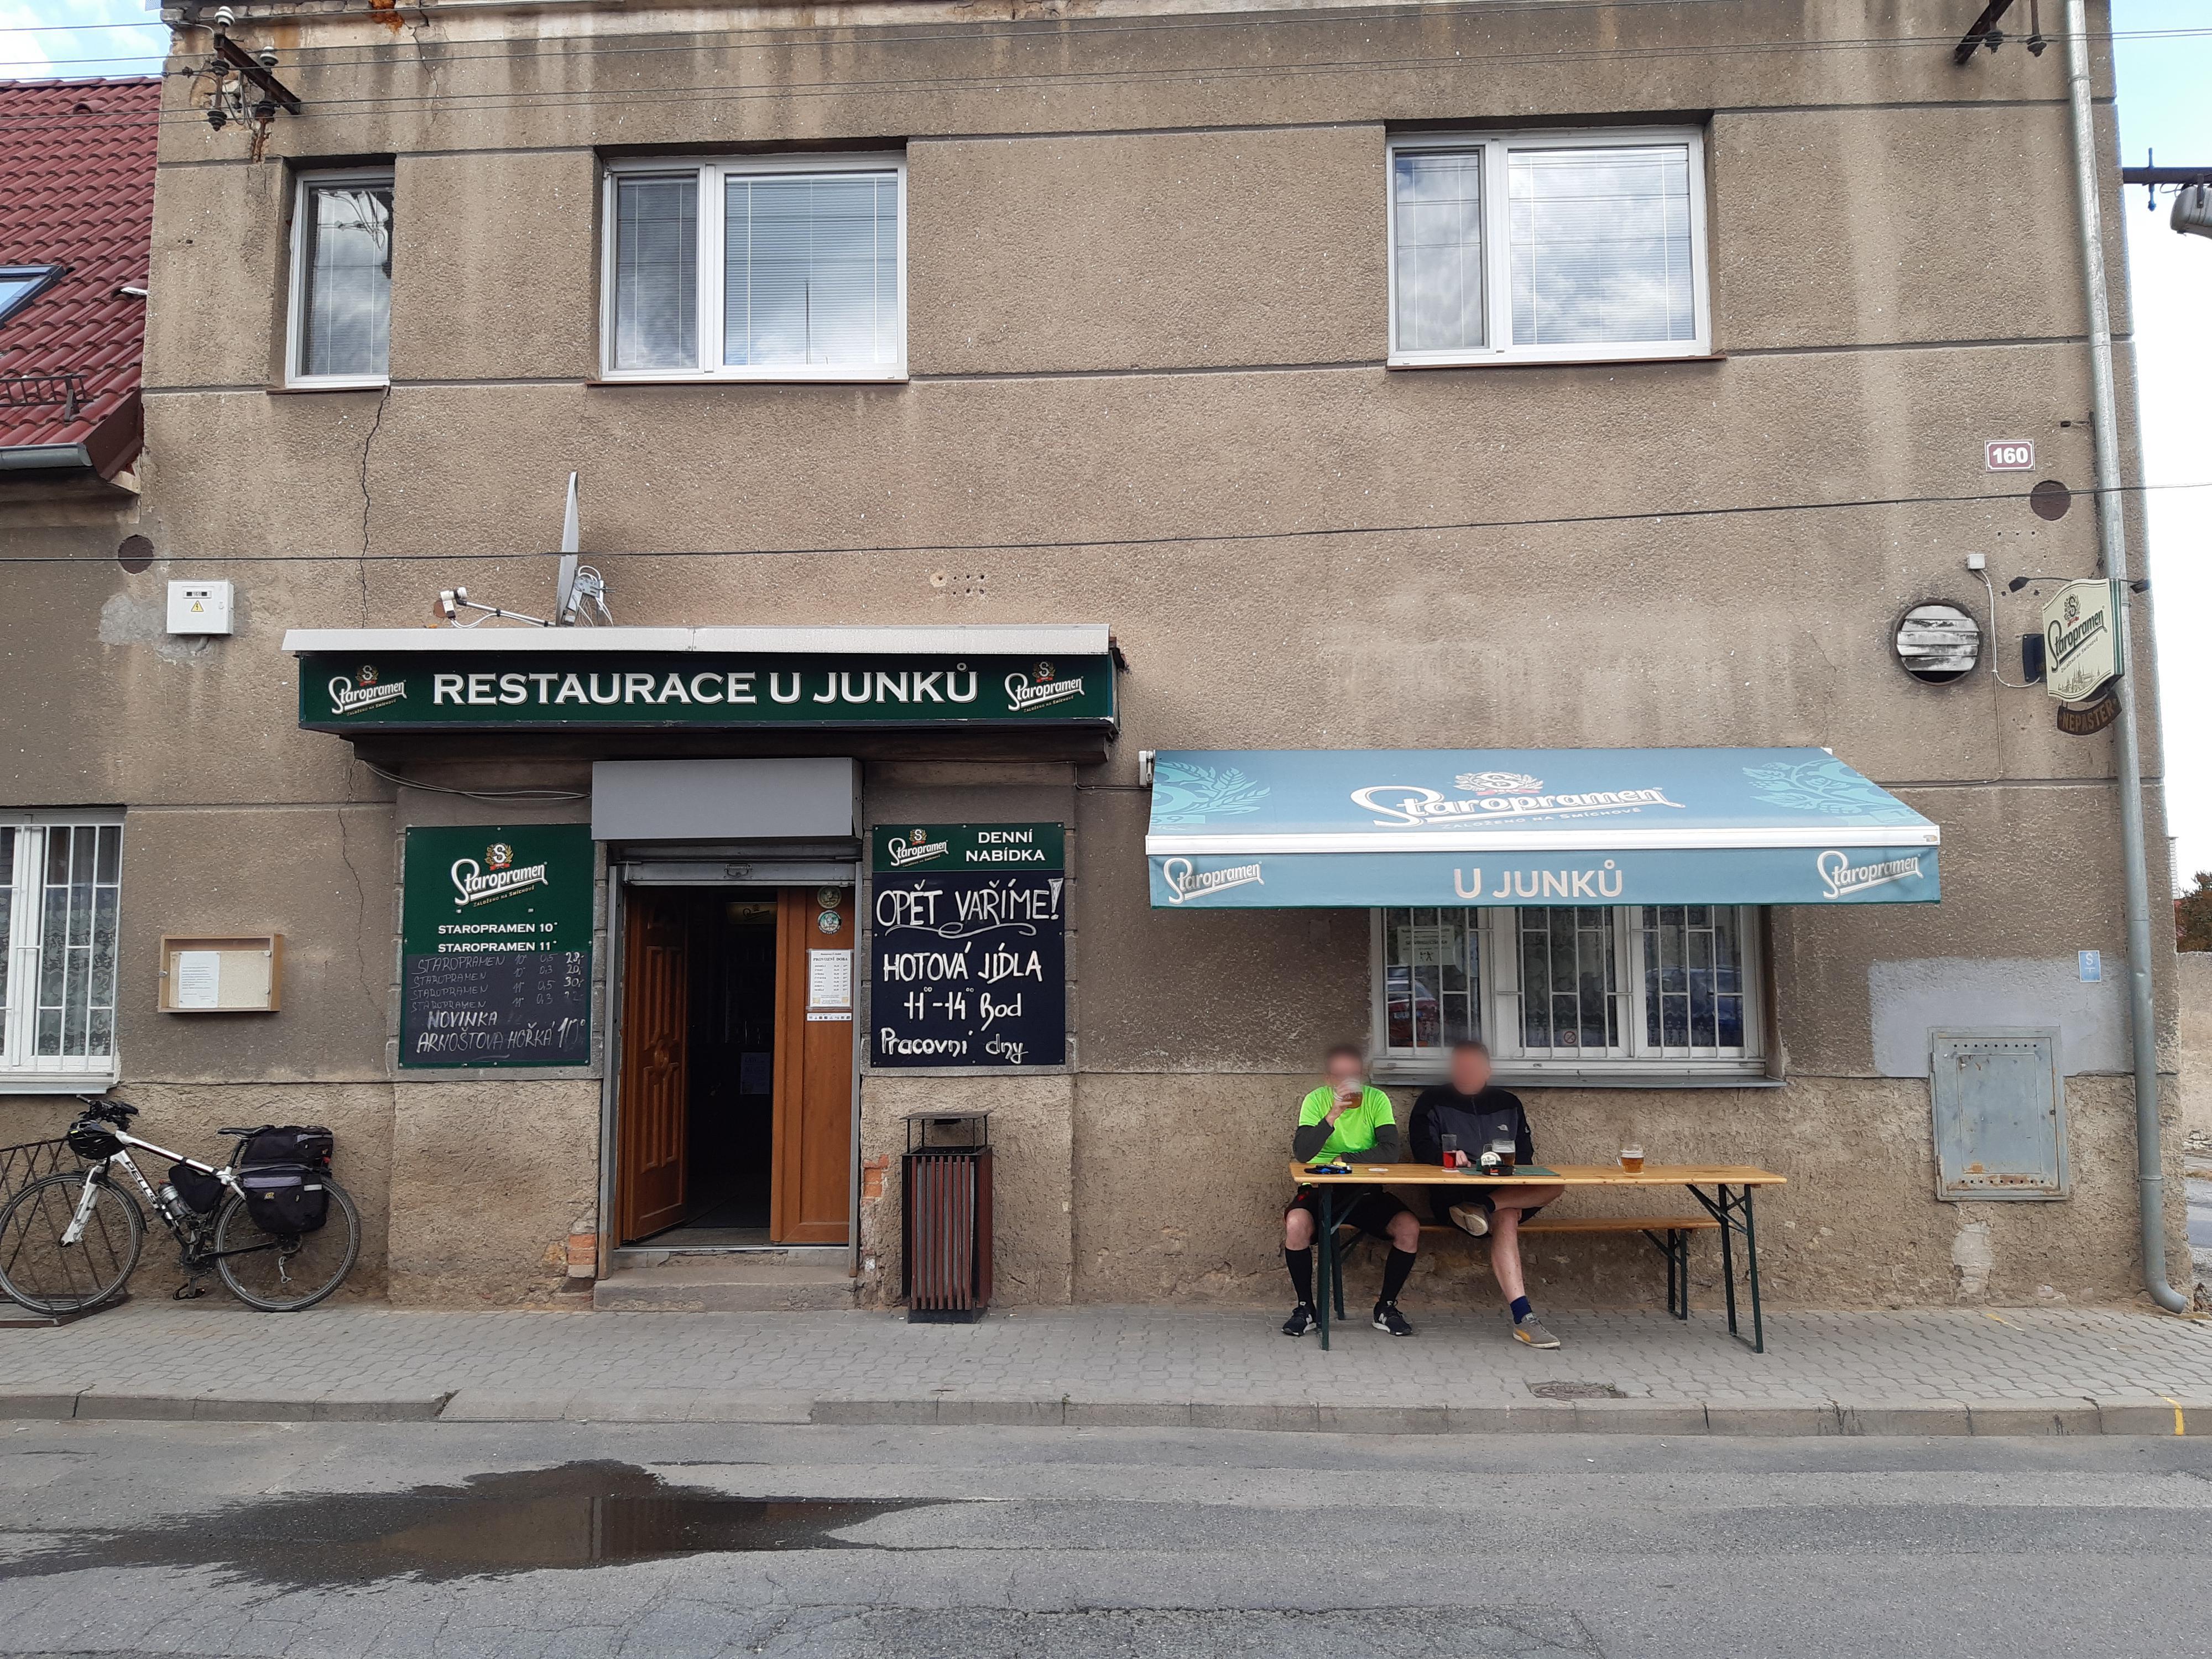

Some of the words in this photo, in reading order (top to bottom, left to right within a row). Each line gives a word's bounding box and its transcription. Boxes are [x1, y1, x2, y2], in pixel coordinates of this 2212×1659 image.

[1993, 447, 2028, 464] 160
[2048, 609, 2107, 674] Staropramen
[328, 676, 408, 714] Staropramen
[432, 672, 758, 705] RESTAURACE
[769, 672, 801, 704] U
[813, 662, 979, 704] JUNKŮ
[1004, 672, 1086, 712] Staropramen
[2063, 698, 2115, 732] NEPASTER
[1350, 785, 1686, 827] Staropramen
[888, 837, 949, 867] Staropramen
[978, 828, 1033, 844] DENNÍ
[966, 847, 1046, 862] NABÍDKA
[451, 858, 549, 906] Staropramen
[1164, 858, 1265, 904] Staropramen
[1454, 868, 1481, 899] U
[1493, 859, 1623, 898] JUNKŮ
[1817, 851, 1924, 899] Staropramen
[877, 879, 943, 926] OPĚT
[955, 878, 1063, 925] VAŘÍME!
[438, 924, 535, 935] STAROPRAMEN
[540, 922, 558, 933] 10°
[438, 942, 535, 953] STAROPRAMEN
[540, 940, 557, 951] 11°
[884, 941, 972, 982] HOTOVÁ
[978, 942, 1043, 984] JÍDLA
[410, 972, 487, 989] STAROPRAMEN
[411, 955, 505, 974] STAROPRAMEN
[410, 984, 489, 1001] STAROPRAMEN
[416, 1027, 504, 1053] ARNOŠTOVA
[508, 1021, 555, 1049] HOŘKÁ
[427, 1011, 498, 1031] NOVINKA
[880, 1027, 974, 1057] Pracovní
[985, 1033, 1029, 1064] dny
